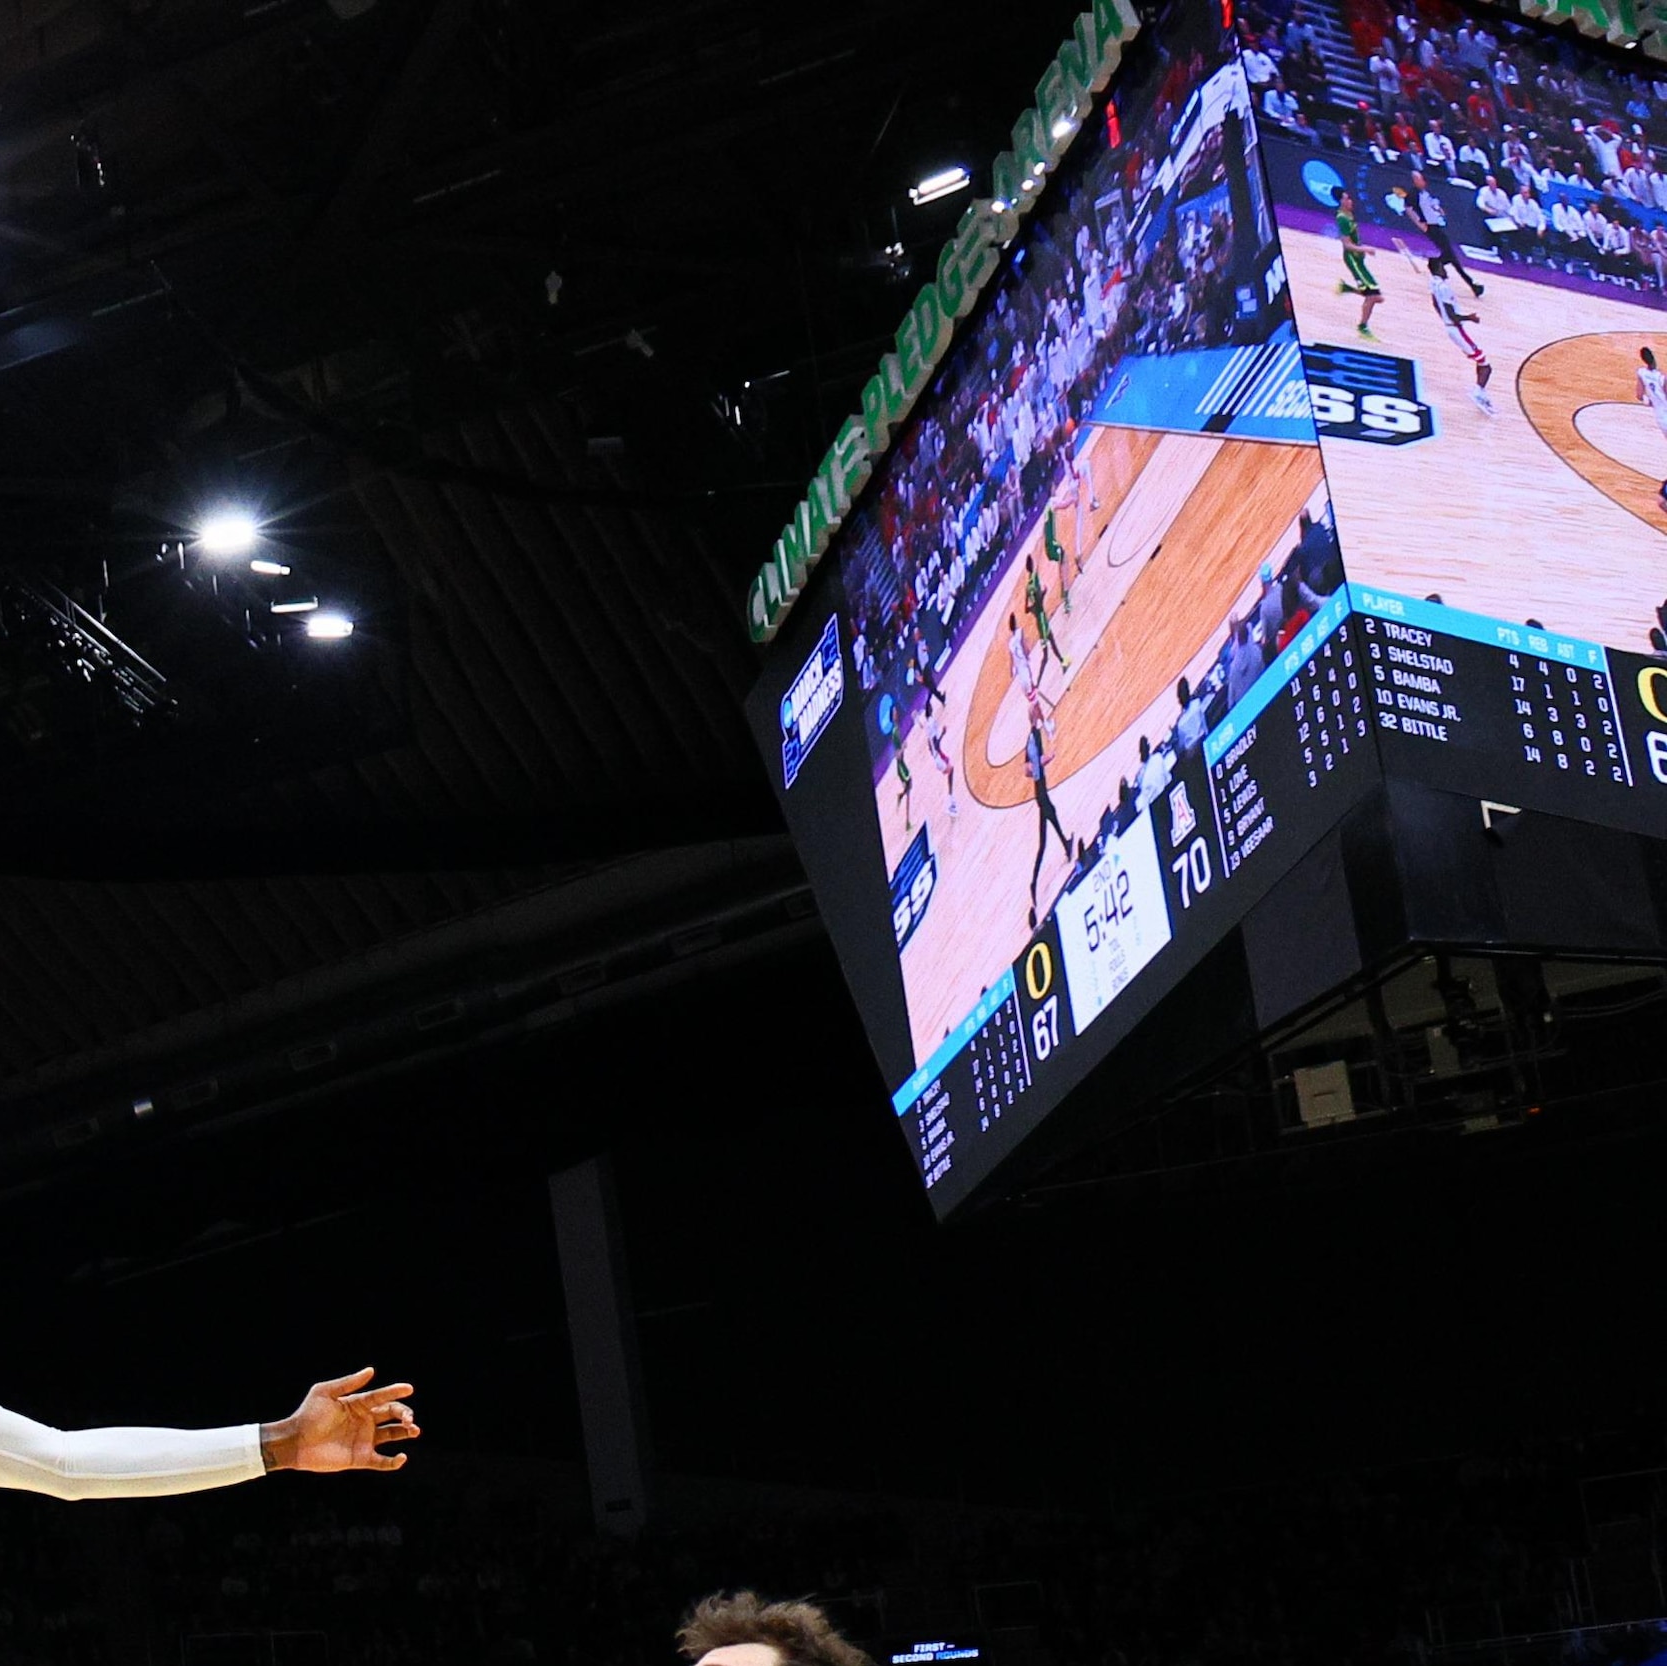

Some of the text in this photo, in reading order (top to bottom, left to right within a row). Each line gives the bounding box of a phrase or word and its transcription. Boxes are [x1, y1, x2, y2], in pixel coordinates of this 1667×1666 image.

[1363, 592, 1405, 617] PLAYER
[1497, 626, 1521, 646] PTS
[1527, 634, 1549, 653] REB
[1588, 649, 1597, 664] F
[1365, 618, 1603, 690] 2 TRACEY 4 4 0 2
[1369, 643, 1609, 712] 3 SHELSTAD 17 1 1 0
[1374, 666, 1613, 736] 5 BAMBA 14 3 3 2
[1375, 688, 1618, 759] 10 EVANS JR. 6 8 0 2
[1378, 711, 1623, 783] 32 BITTLE 14 8 2 2
[1092, 860, 1112, 893] 2ND
[1173, 837, 1212, 909] 70
[1083, 870, 1134, 952] 5:42
[1032, 995, 1060, 1061] 67
[892, 1649, 979, 1664] SECOND ROUNDS
[913, 1643, 945, 1653] FIRST
